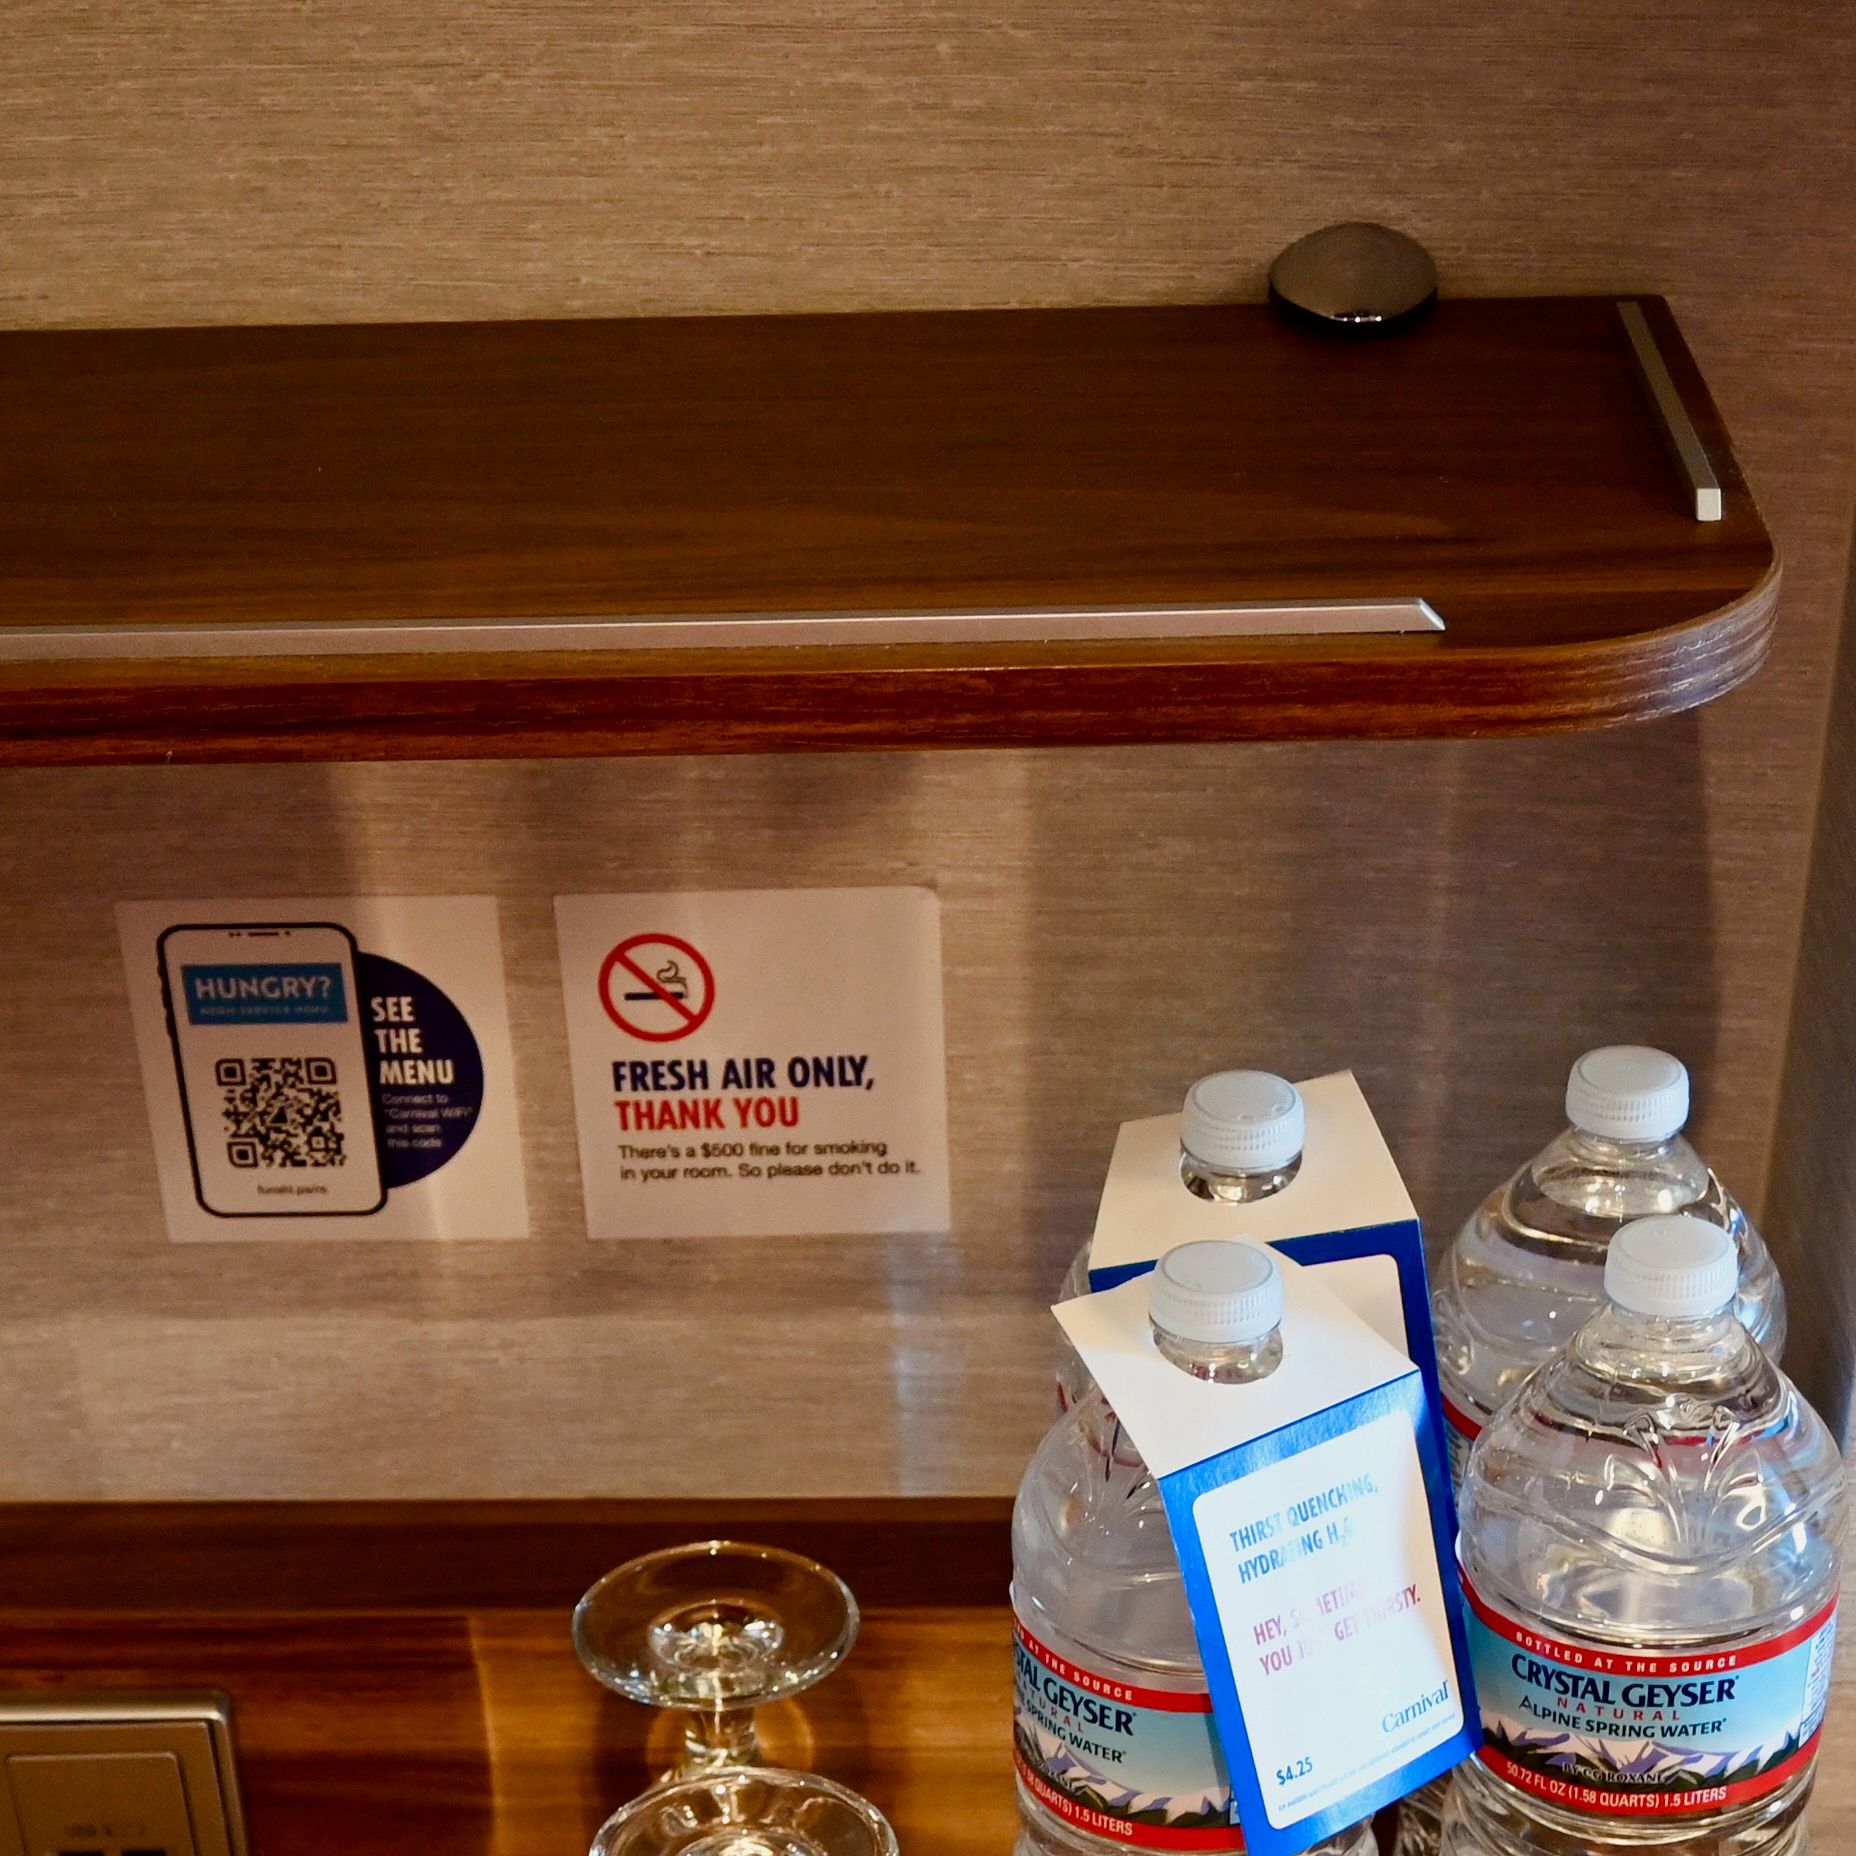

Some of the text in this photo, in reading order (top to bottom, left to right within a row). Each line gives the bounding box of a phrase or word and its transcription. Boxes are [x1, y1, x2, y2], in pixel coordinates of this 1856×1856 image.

[195, 976, 332, 999] HUNGRY?
[371, 996, 414, 1022] SEE
[374, 1029, 423, 1053] THE
[380, 1059, 455, 1085] MENU
[612, 1055, 874, 1091] FRESH AIR ONLY,
[614, 1096, 799, 1131] THANK YOU
[618, 1139, 887, 1159] There's a $500 fine for smoking
[620, 1159, 921, 1182] in your room. So please don't do it.
[1230, 1473, 1378, 1552] THIRST QUENCHING,
[1253, 1616, 1287, 1645] HEY,
[1260, 1646, 1293, 1676] YOU
[1516, 1631, 1738, 1673] BOTTLED AT THE SOURCE
[1028, 1640, 1133, 1701] AT THE SOURCE
[1511, 1653, 1736, 1708] CRYSTAL GEYSER
[1043, 1679, 1134, 1736] GEYSER
[1381, 1679, 1449, 1733] Carnival
[1518, 1695, 1723, 1738] ALPINE SPRING WATER
[1557, 1697, 1680, 1721] NATURAL
[1026, 1702, 1123, 1764] SPRING WATER
[1276, 1757, 1313, 1786] $4.25
[1506, 1761, 1727, 1808] 50.72 FL OZ (1.58 QUARTS) 1.5 LITERS
[1034, 1780, 1073, 1817] QUARTS)
[1075, 1806, 1090, 1823] 1.5
[1092, 1811, 1133, 1836] LITERS
